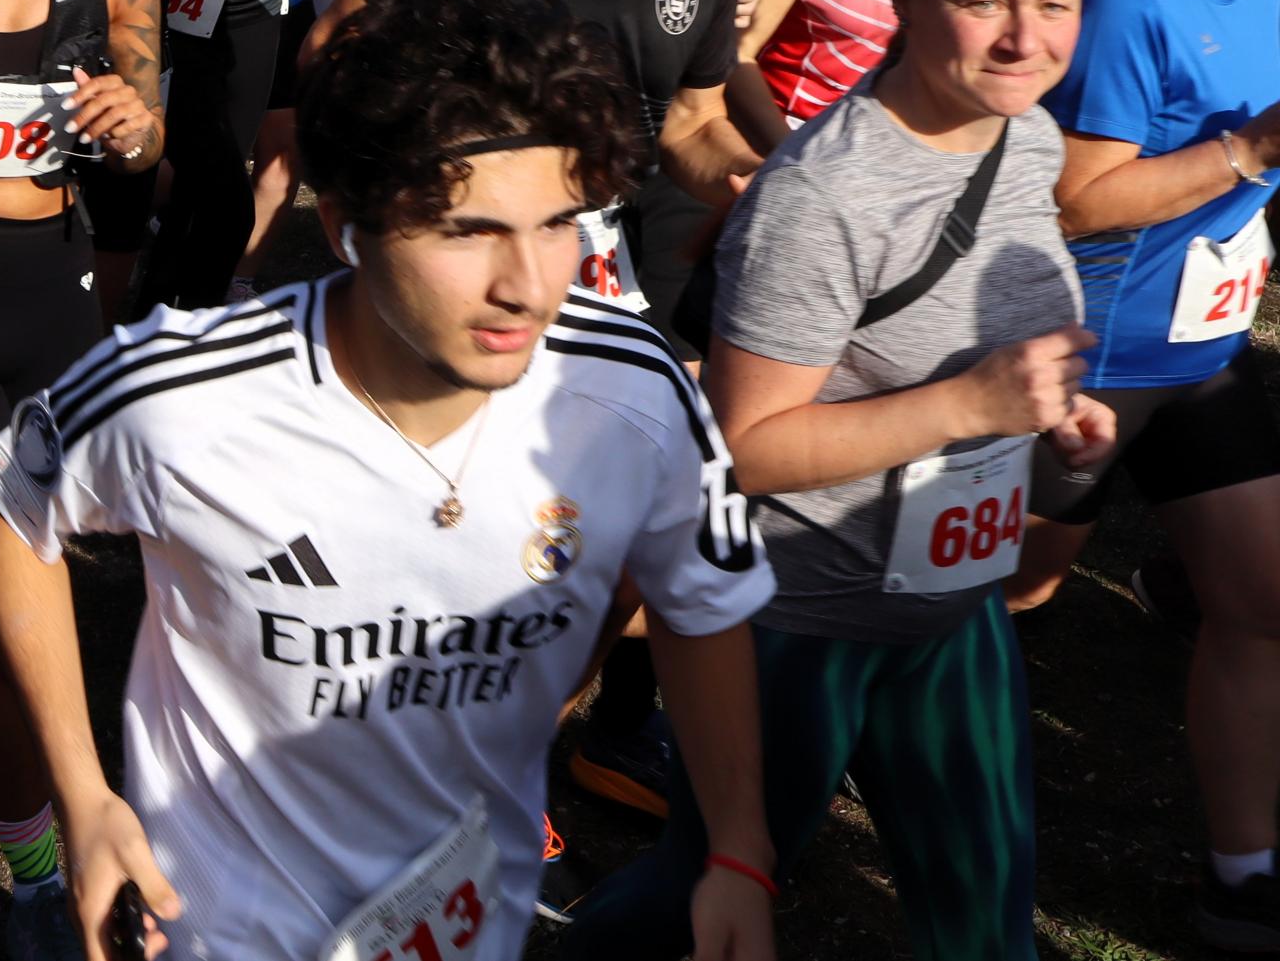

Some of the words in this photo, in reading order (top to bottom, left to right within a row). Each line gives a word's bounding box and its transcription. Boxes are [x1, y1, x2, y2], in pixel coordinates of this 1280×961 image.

[929, 485, 1023, 568] 684
[257, 600, 575, 669] Emirates
[309, 674, 377, 722] FLY
[387, 656, 524, 714] BETTER
